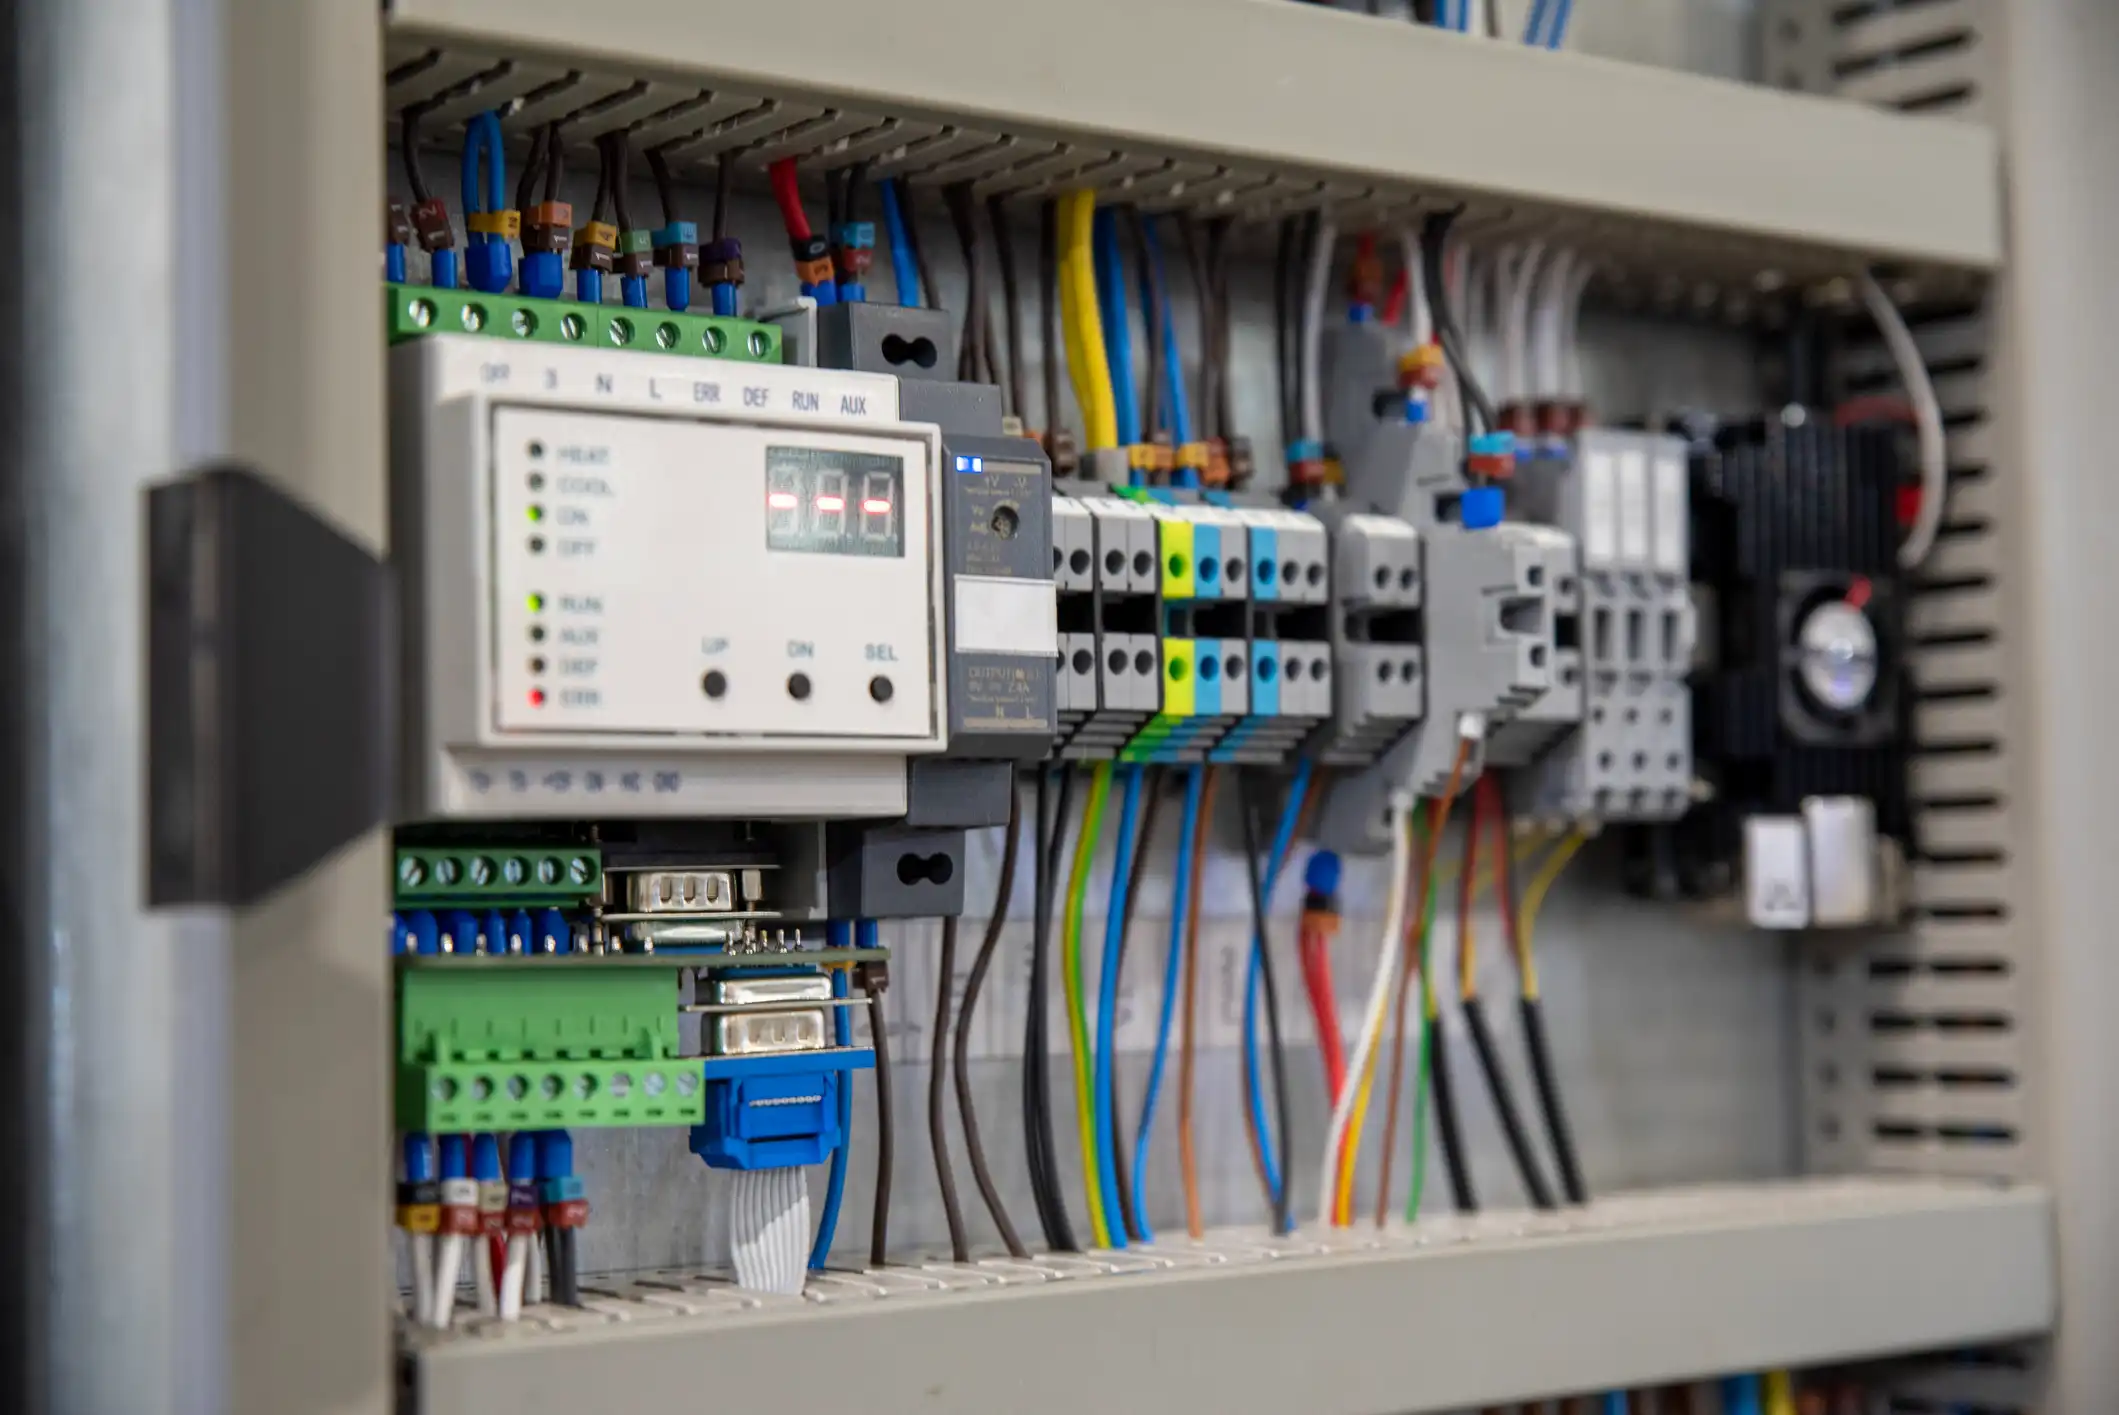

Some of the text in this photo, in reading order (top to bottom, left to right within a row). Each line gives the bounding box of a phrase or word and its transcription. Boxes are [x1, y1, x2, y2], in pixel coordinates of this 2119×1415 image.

[648, 376, 662, 401] L
[693, 381, 721, 403] ERR
[743, 386, 770, 408] DEF
[792, 389, 819, 412] RUN
[840, 394, 867, 416] AUX
[865, 642, 899, 662] SEL
